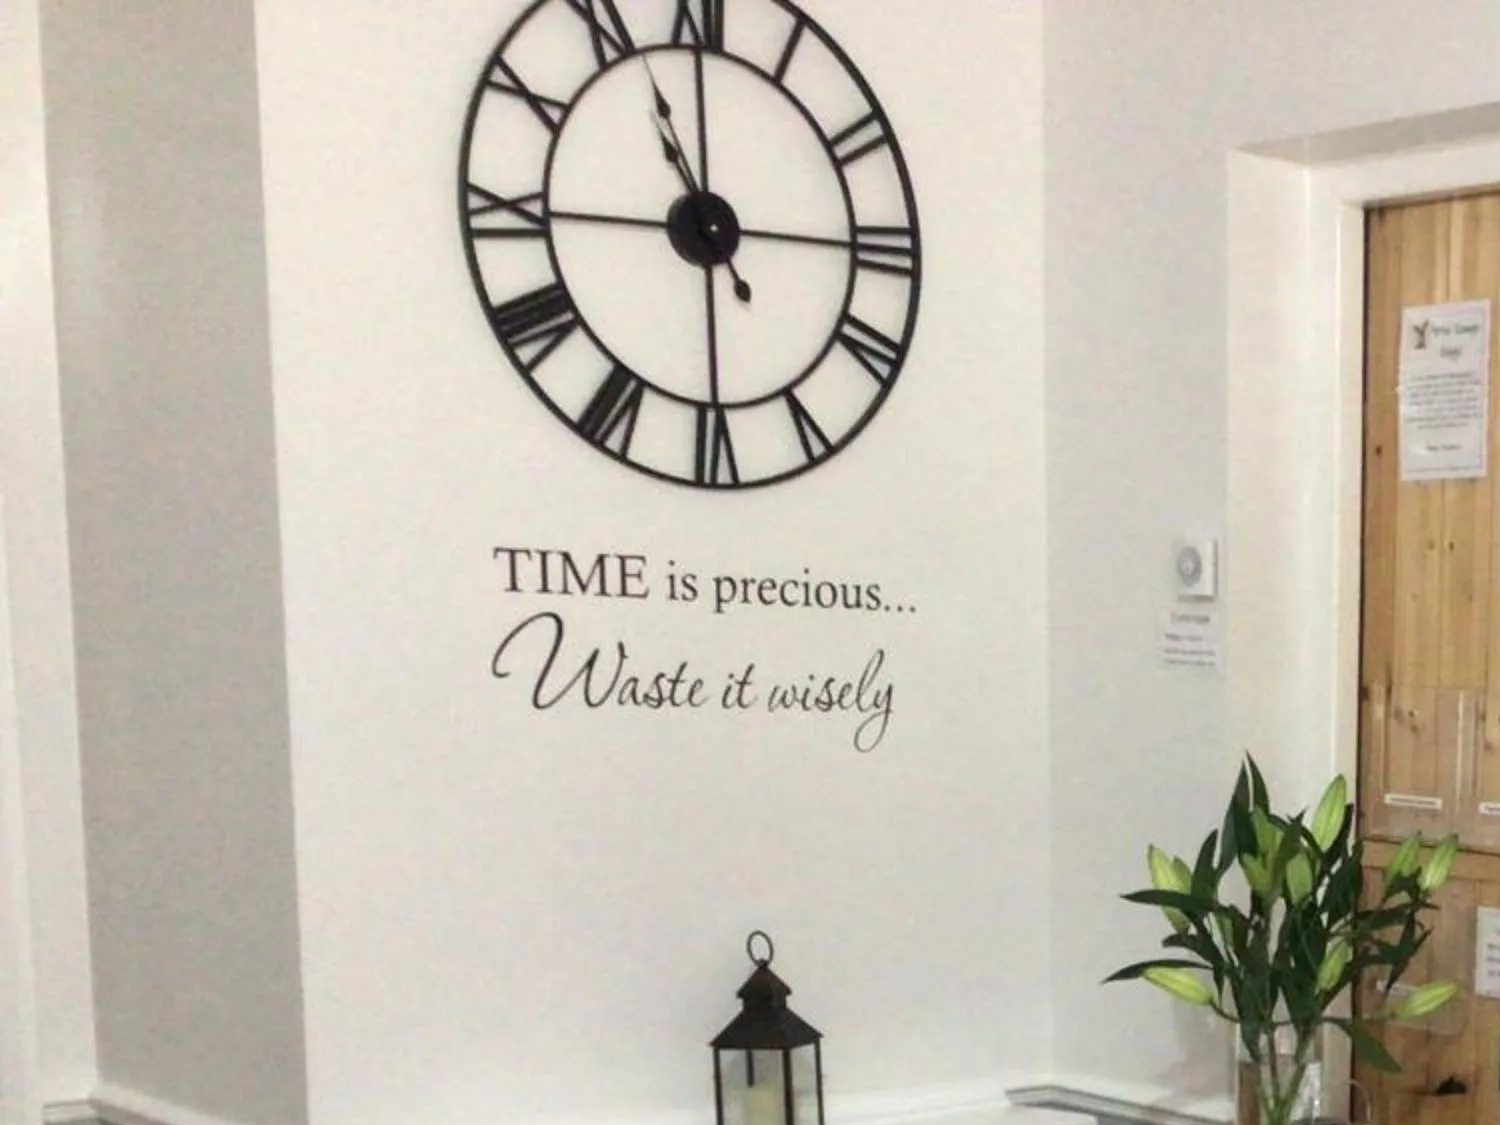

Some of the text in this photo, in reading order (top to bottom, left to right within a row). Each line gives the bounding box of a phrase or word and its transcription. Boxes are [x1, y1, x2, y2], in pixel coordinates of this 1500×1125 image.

[493, 546, 918, 615] TIME is precious...
[491, 611, 895, 754] Waste it wisely
